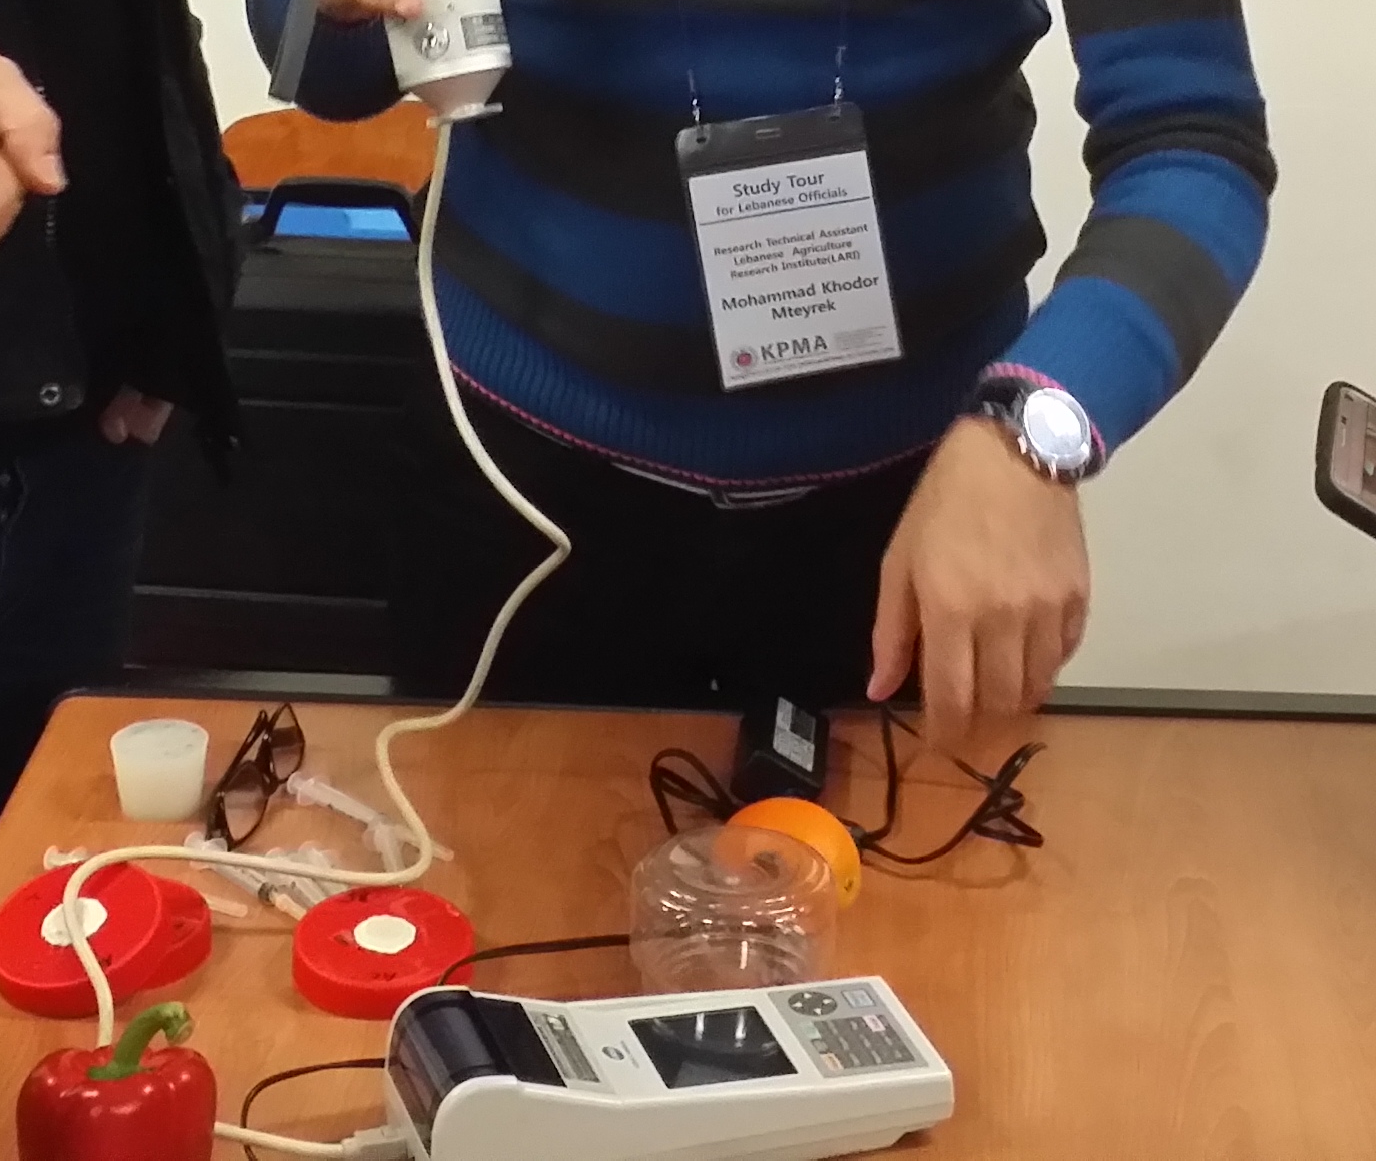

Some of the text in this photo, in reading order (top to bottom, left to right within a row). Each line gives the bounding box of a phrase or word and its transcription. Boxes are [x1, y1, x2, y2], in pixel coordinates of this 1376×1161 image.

[733, 173, 825, 198] Study Tour
[716, 187, 848, 217] for Lebanese Officials
[713, 223, 869, 256] Research Technical Assistant
[733, 241, 853, 266] Lebanese Agriculture
[730, 264, 778, 280] Research
[721, 275, 880, 311] Mohammad Khodor
[771, 298, 837, 321] Mteyrek
[760, 334, 829, 361] KPMA
